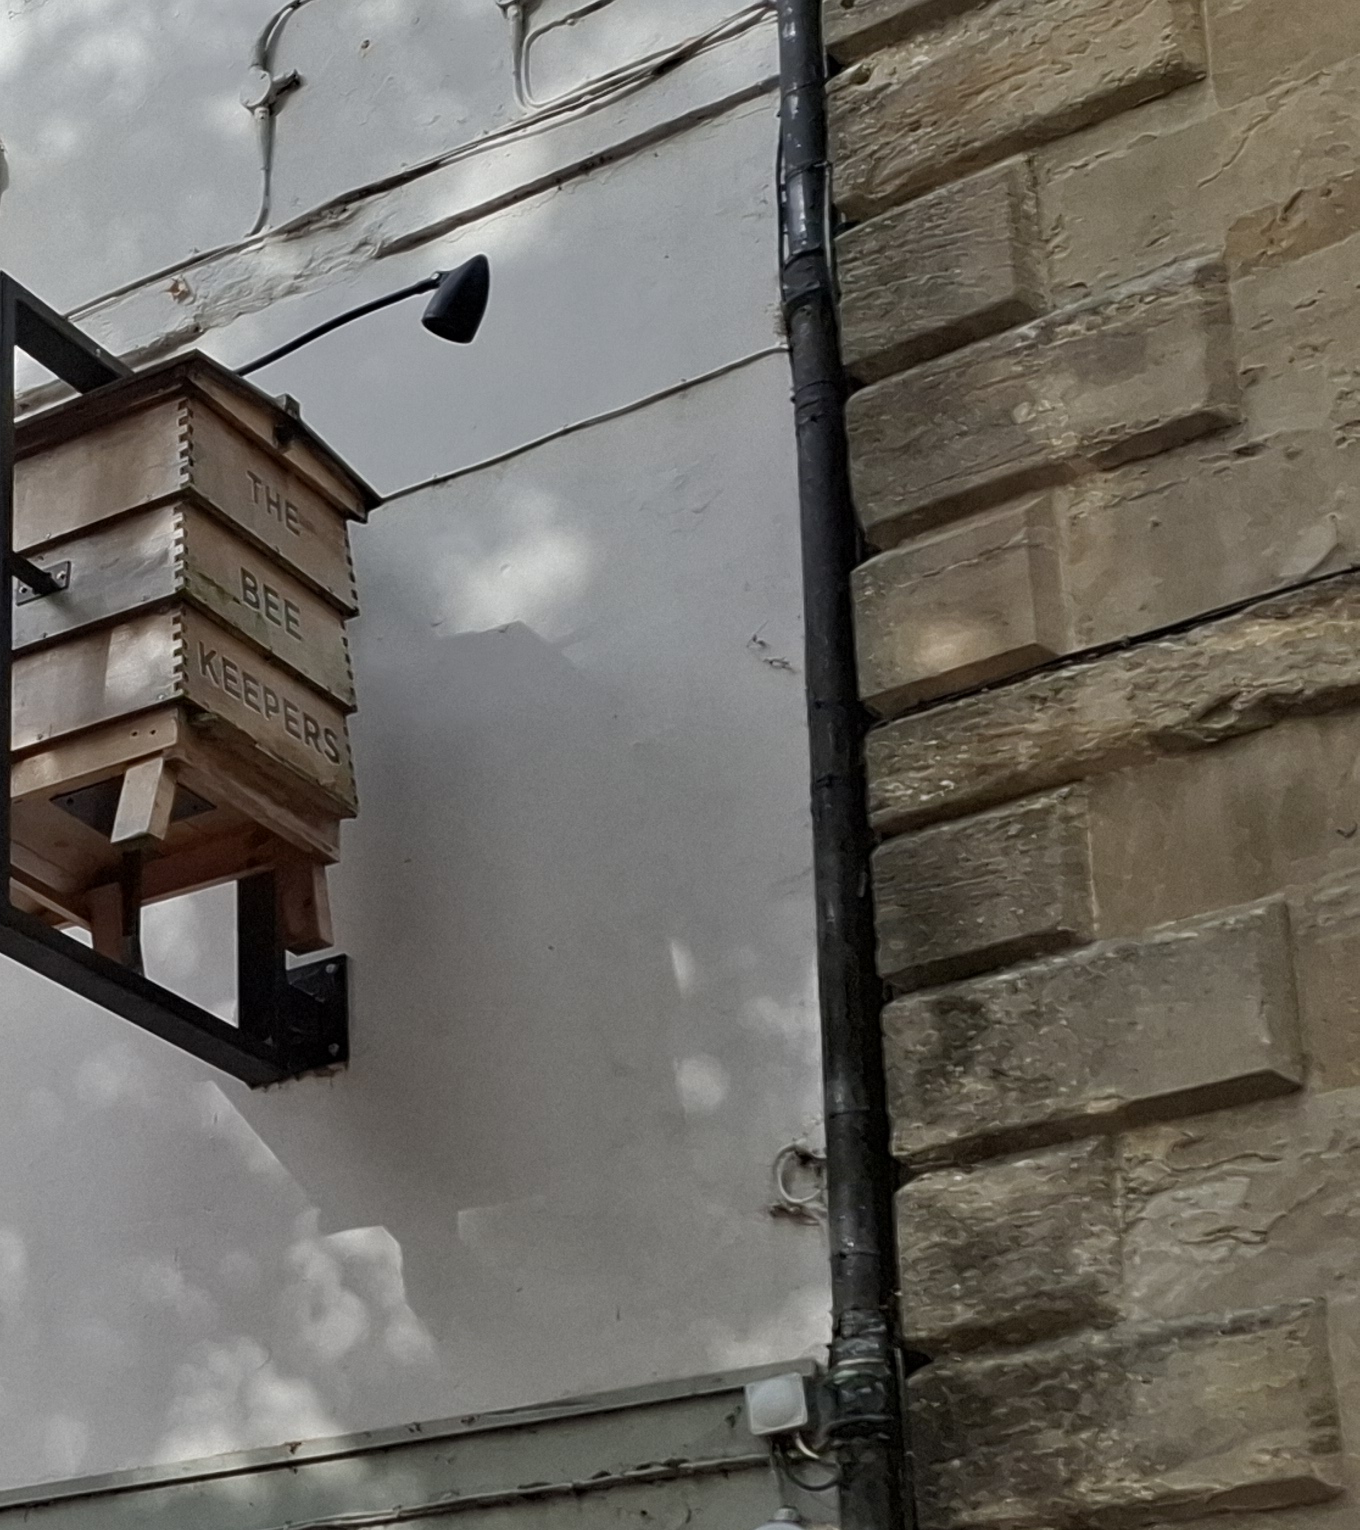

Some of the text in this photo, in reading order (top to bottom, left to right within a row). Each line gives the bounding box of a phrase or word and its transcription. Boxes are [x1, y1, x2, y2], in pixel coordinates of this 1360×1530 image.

[246, 470, 303, 537] THE
[240, 566, 304, 641] BEE
[198, 641, 343, 765] KEEPERS
